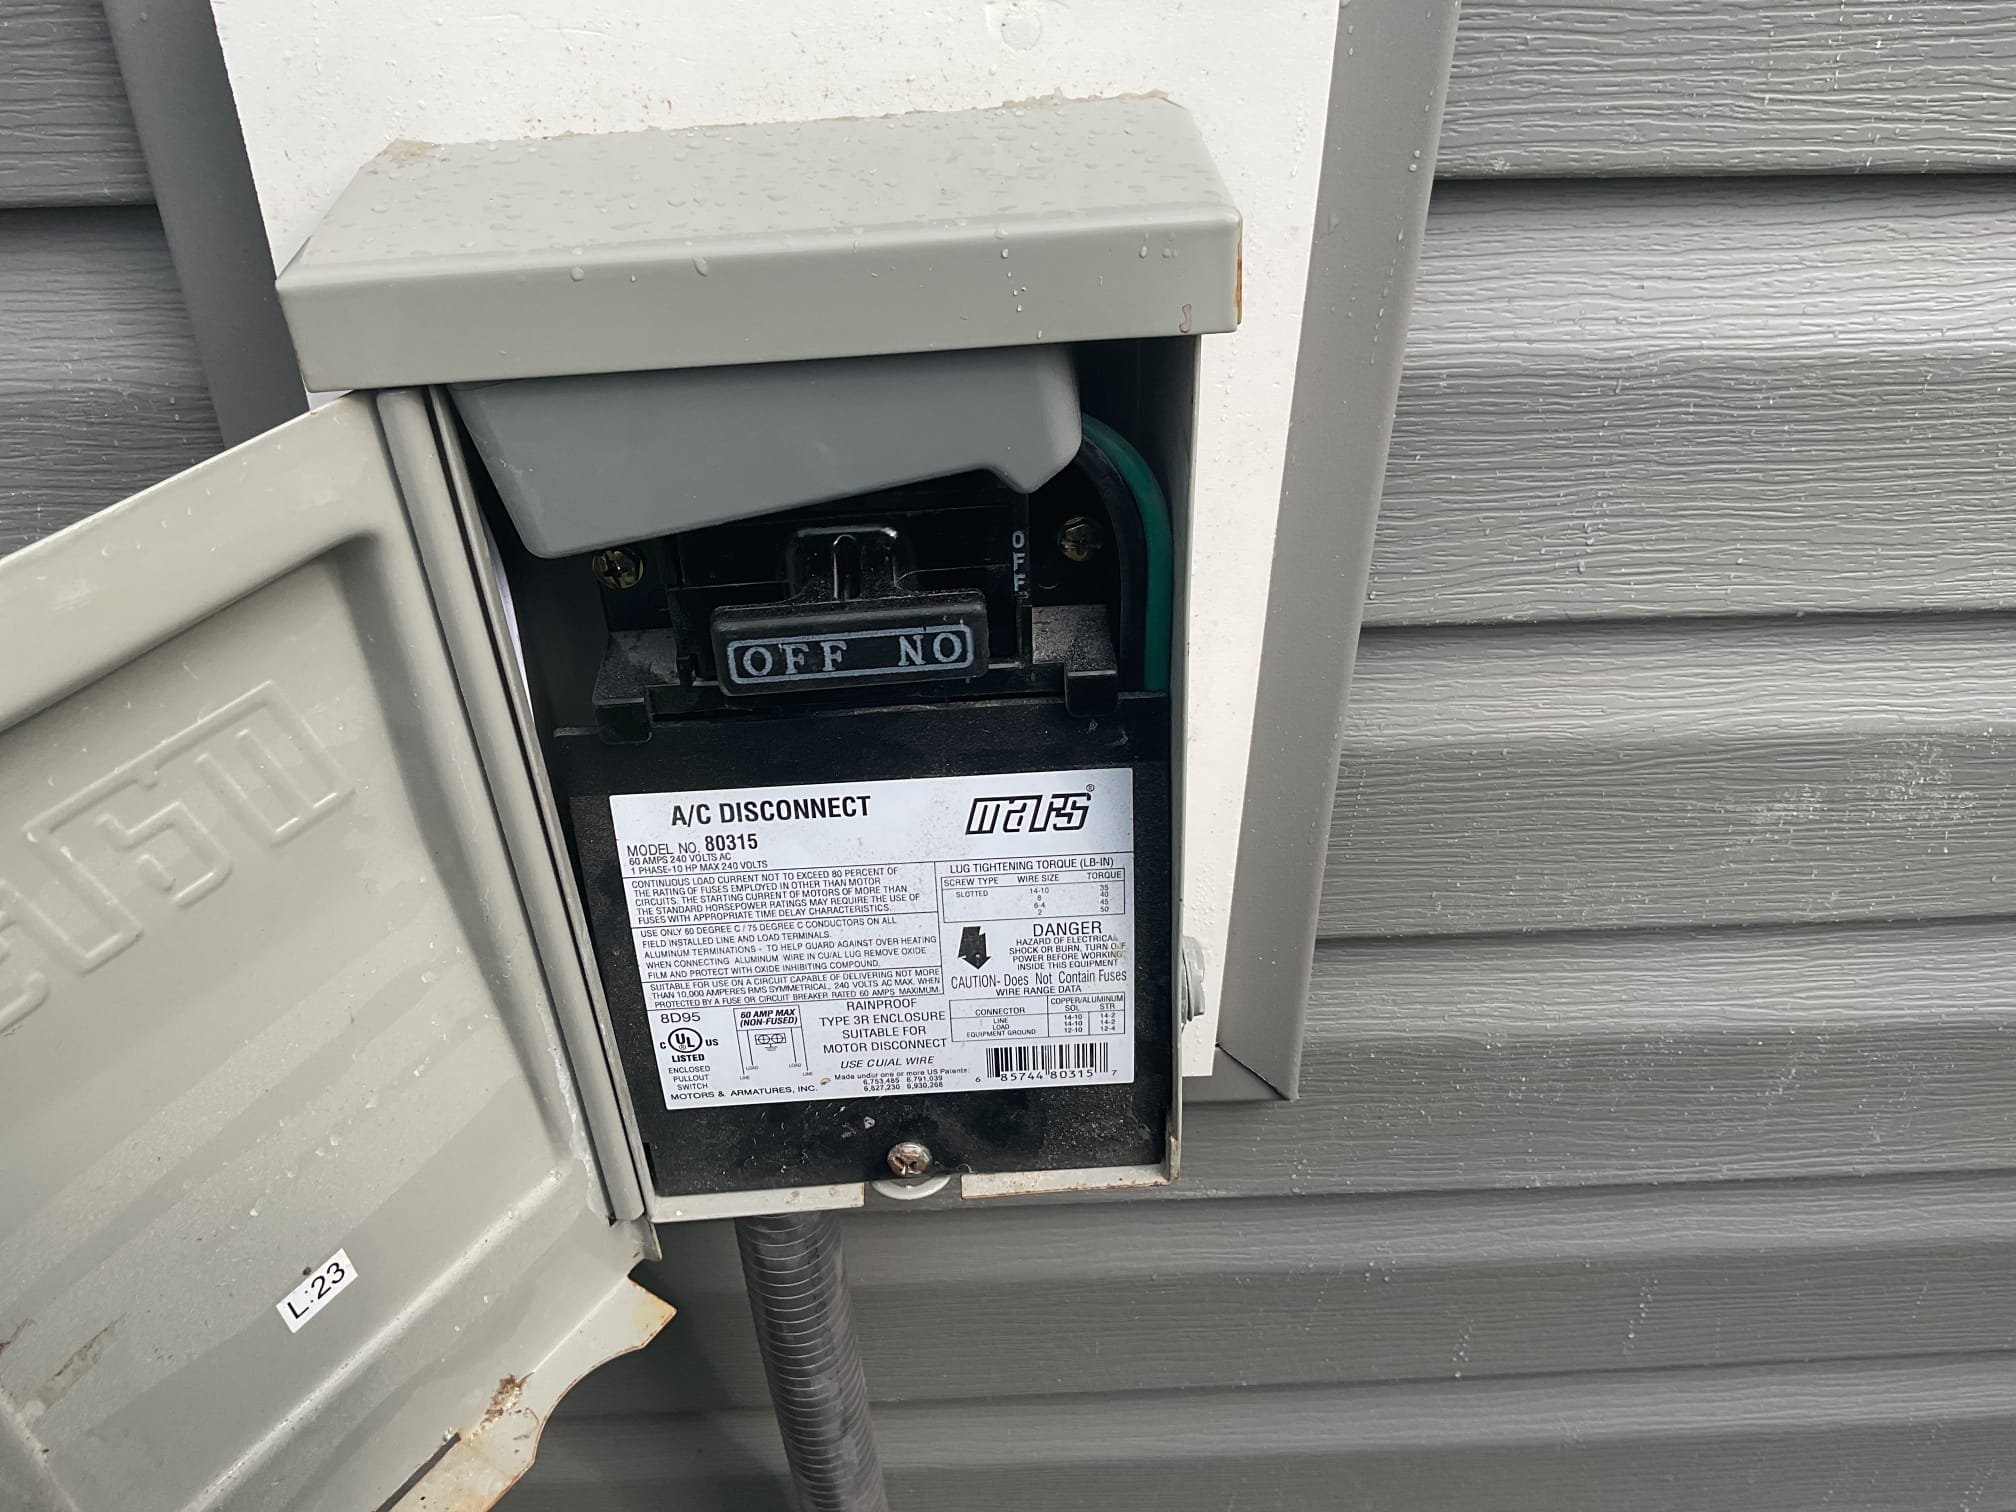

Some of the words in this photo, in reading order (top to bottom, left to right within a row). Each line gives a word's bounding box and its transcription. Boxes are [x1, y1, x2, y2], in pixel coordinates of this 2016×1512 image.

[1012, 530, 1026, 592] OFF
[742, 640, 847, 677] OFF
[668, 803, 712, 827] A/C
[718, 795, 871, 824] DISCONNECT
[626, 843, 673, 856] MODEL
[677, 841, 700, 853] NO.
[704, 833, 758, 851] 80315
[628, 857, 640, 865] 60
[641, 855, 668, 864] AMPS
[669, 854, 687, 863] 240
[688, 853, 717, 862] VOLTS
[719, 852, 731, 860] AC
[631, 867, 635, 875] 1
[638, 865, 682, 874] PHASE-10
[684, 864, 698, 872] HP
[699, 863, 720, 871] MAX
[721, 862, 738, 870] 240
[740, 860, 767, 869] VOLTS
[950, 864, 970, 875] LUG
[974, 861, 1033, 874] TIGHTENING
[1036, 859, 1076, 870] TORQUE
[1079, 857, 1113, 868] (LB-IN)
[631, 877, 690, 888] CONTINUOUS
[692, 876, 715, 885] LOAD
[717, 874, 759, 883] CURRENT
[761, 873, 779, 881] NOT
[783, 872, 793, 880] TO
[796, 870, 829, 879] EXCEED
[831, 869, 841, 877] 80
[844, 867, 883, 877] PERCENT
[887, 866, 898, 874] OF
[943, 878, 974, 887] SCREW
[978, 877, 998, 885] TYPE
[1017, 875, 1038, 883] WIRE
[1087, 871, 1121, 880] TORQUE
[633, 889, 651, 897] THE
[652, 887, 685, 896] RATING
[686, 886, 698, 894] OF
[700, 885, 728, 894] FUSES
[730, 882, 777, 892] EMPLOYED
[791, 880, 823, 889] OTHER
[824, 878, 846, 887] THAN
[848, 877, 880, 886] MOTOR
[638, 915, 666, 924] FUSES
[667, 914, 690, 922] WITH
[693, 911, 752, 921] APPROPRIATE
[755, 909, 776, 918] TIME
[778, 908, 806, 916] DELAY
[1033, 920, 1101, 937] DANGER
[641, 939, 666, 947] FIELD
[668, 937, 713, 946] INSTALLED
[737, 934, 754, 942] AND
[757, 933, 779, 941] LOAD
[644, 949, 689, 958] ALUMINUM
[692, 945, 756, 955] TERMINATIONS
[780, 943, 802, 951] HELP
[805, 941, 834, 949] GUARD
[837, 939, 873, 947] AGAINST
[875, 937, 898, 945] OVER
[900, 935, 936, 944] HEATING
[1016, 937, 1050, 946] HAZARD
[1009, 946, 1038, 955] SHOCK
[1040, 945, 1052, 953] OR
[1085, 942, 1107, 950] TURN
[1110, 941, 1125, 949] OF
[1012, 954, 1043, 962] POWER
[1081, 950, 1122, 958] WORKING
[1069, 959, 1117, 967] EQUIPMENT
[647, 971, 667, 979] FILM
[689, 967, 728, 976] PROTECT
[730, 966, 752, 974] WITH
[754, 964, 780, 973] OXIDE
[782, 962, 826, 971] INHIBITING
[950, 974, 1000, 989] CAUTION-
[1003, 972, 1028, 986] Does
[1035, 971, 1052, 984] Not
[1058, 969, 1094, 983] Contain
[1098, 967, 1126, 980] Fuses
[995, 988, 1020, 996] WIRE
[1023, 986, 1054, 995] RANGE
[1058, 984, 1081, 993] DATA
[846, 997, 917, 1010] RAINPROOF
[1050, 994, 1122, 1005] COPPER/ALUMINUM
[659, 1012, 700, 1023] 8D95
[819, 1016, 849, 1026] TYPE
[853, 1015, 869, 1024] 3R
[872, 1010, 945, 1023] ENCLOSURE
[975, 1007, 1025, 1016] CONNECTOR
[739, 1016, 798, 1027] (NON-FUSED)
[842, 1027, 899, 1039] SUITABLE
[902, 1025, 926, 1035] FOR
[966, 1030, 1004, 1038] EQUIPMENT
[674, 1033, 694, 1048] UL
[823, 1042, 867, 1053] MOTOR
[871, 1038, 947, 1050] DISCONNECT
[671, 1054, 705, 1062] LISTED
[840, 1060, 863, 1068] USE
[867, 1057, 901, 1067] CU/AL
[905, 1055, 934, 1065] WIRE
[668, 1065, 710, 1073] ENCLOSED
[1050, 1069, 1093, 1078] 80315
[673, 1074, 709, 1082] PULLOUT
[1000, 1072, 1042, 1081] 85744
[677, 1082, 708, 1090] SWITCH
[670, 1091, 714, 1100] MOTORS
[730, 1087, 795, 1096] ARMATURES,
[287, 1262, 345, 1320] L:23
